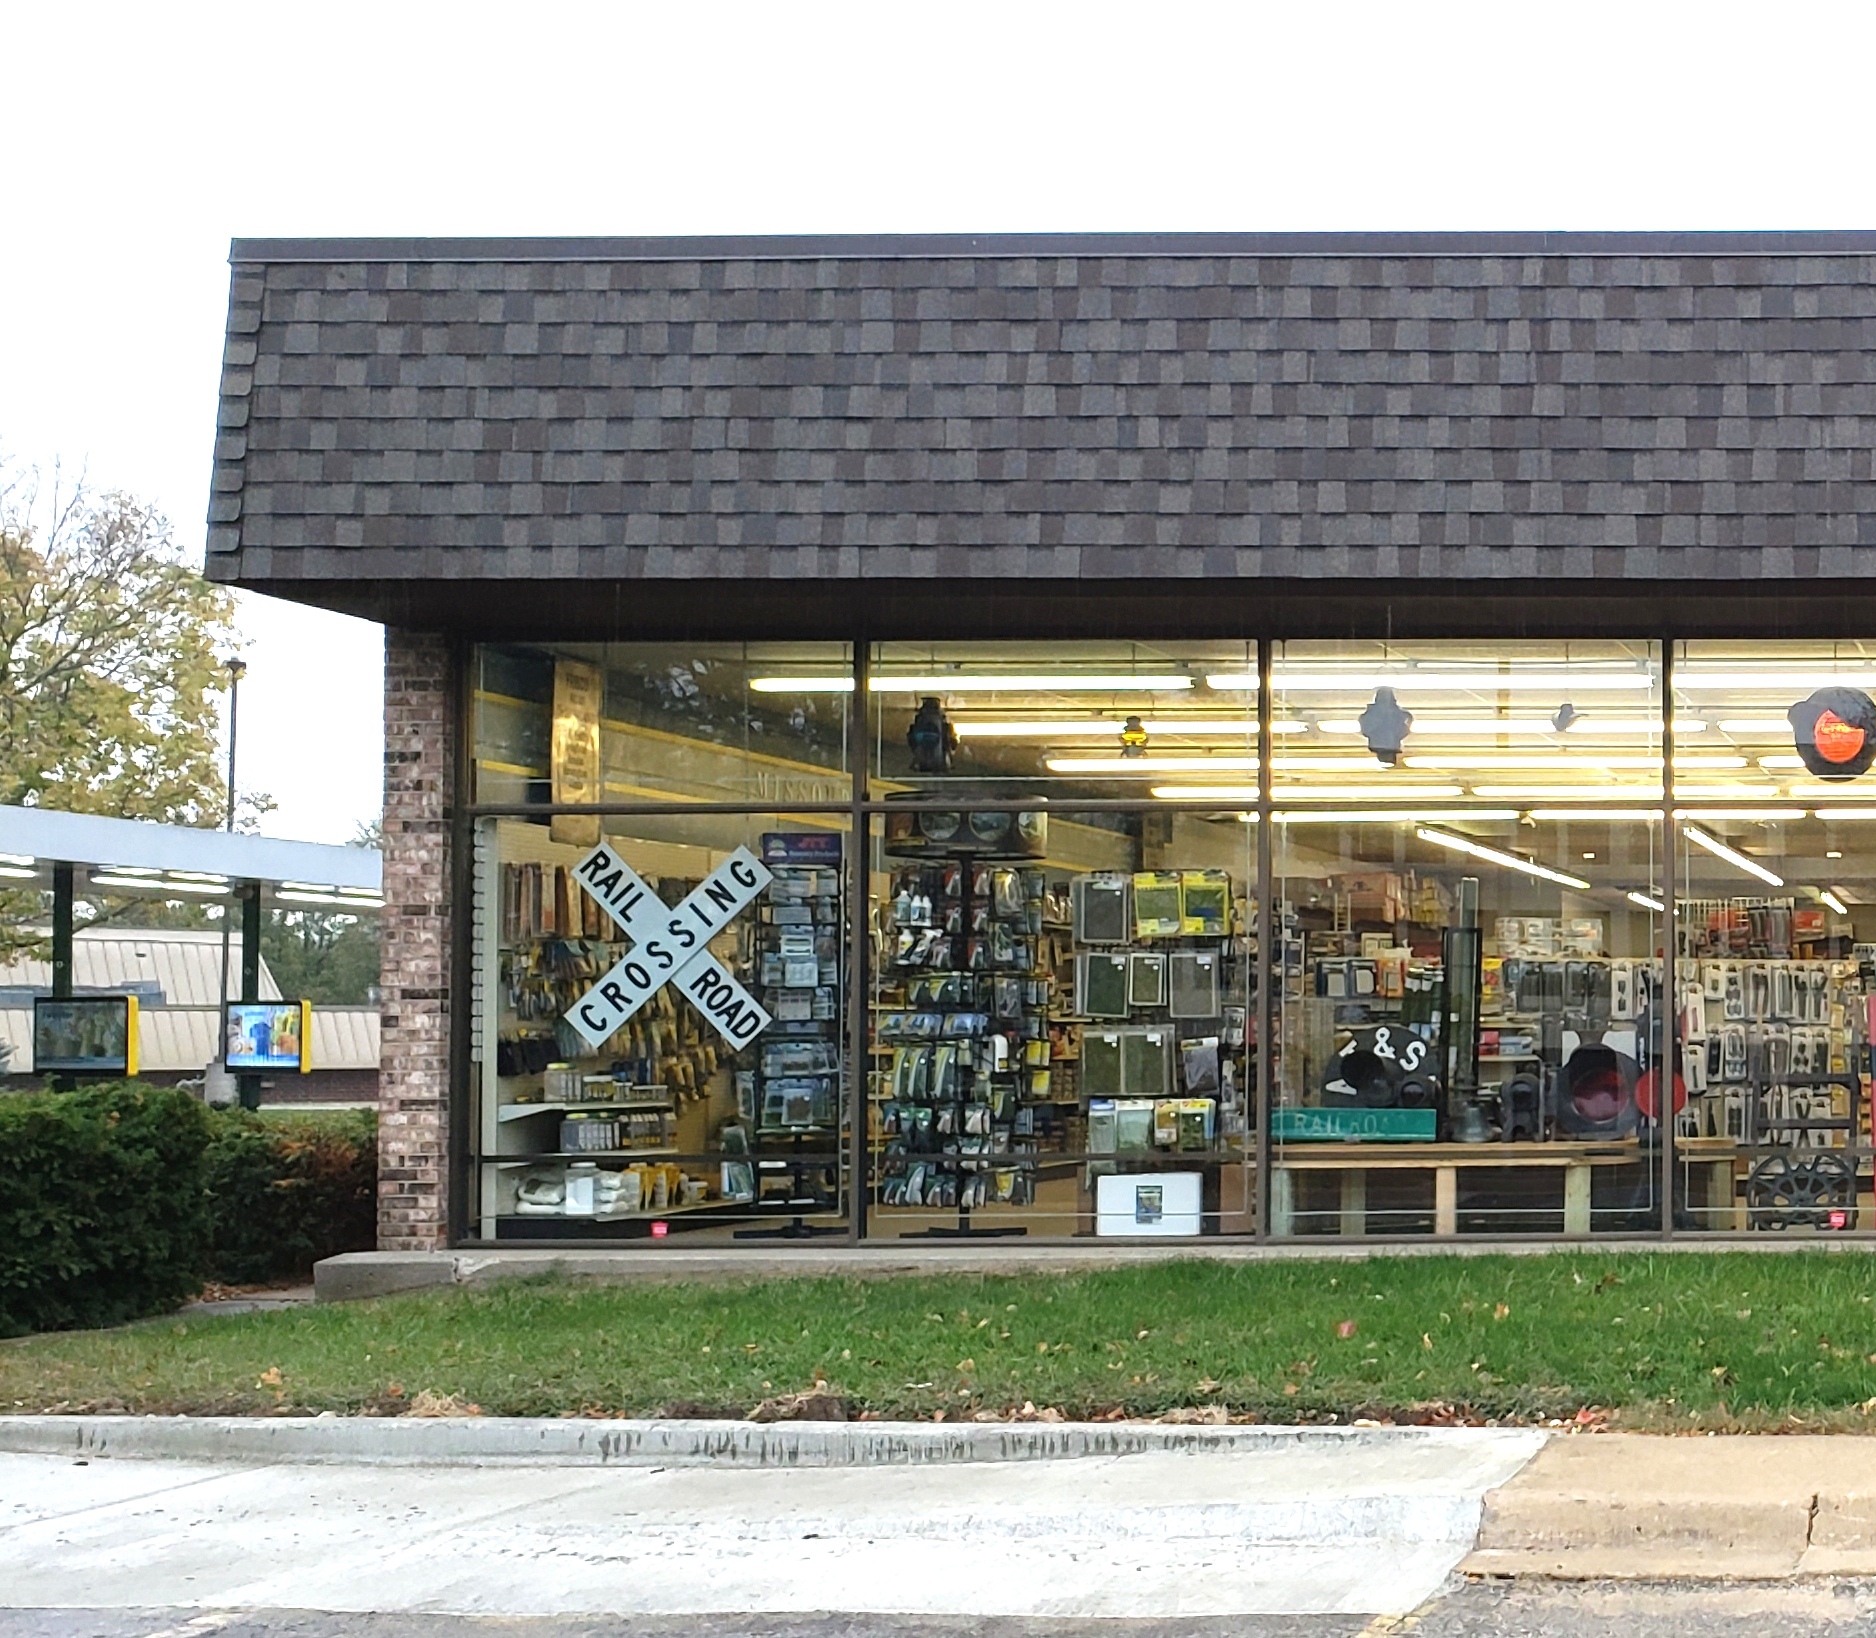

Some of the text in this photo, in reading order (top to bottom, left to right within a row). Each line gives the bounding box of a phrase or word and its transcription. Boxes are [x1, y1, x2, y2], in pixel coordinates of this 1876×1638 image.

[579, 849, 645, 923] RAIL
[579, 860, 757, 1032] CROSSING
[689, 967, 761, 1039] ROAD
